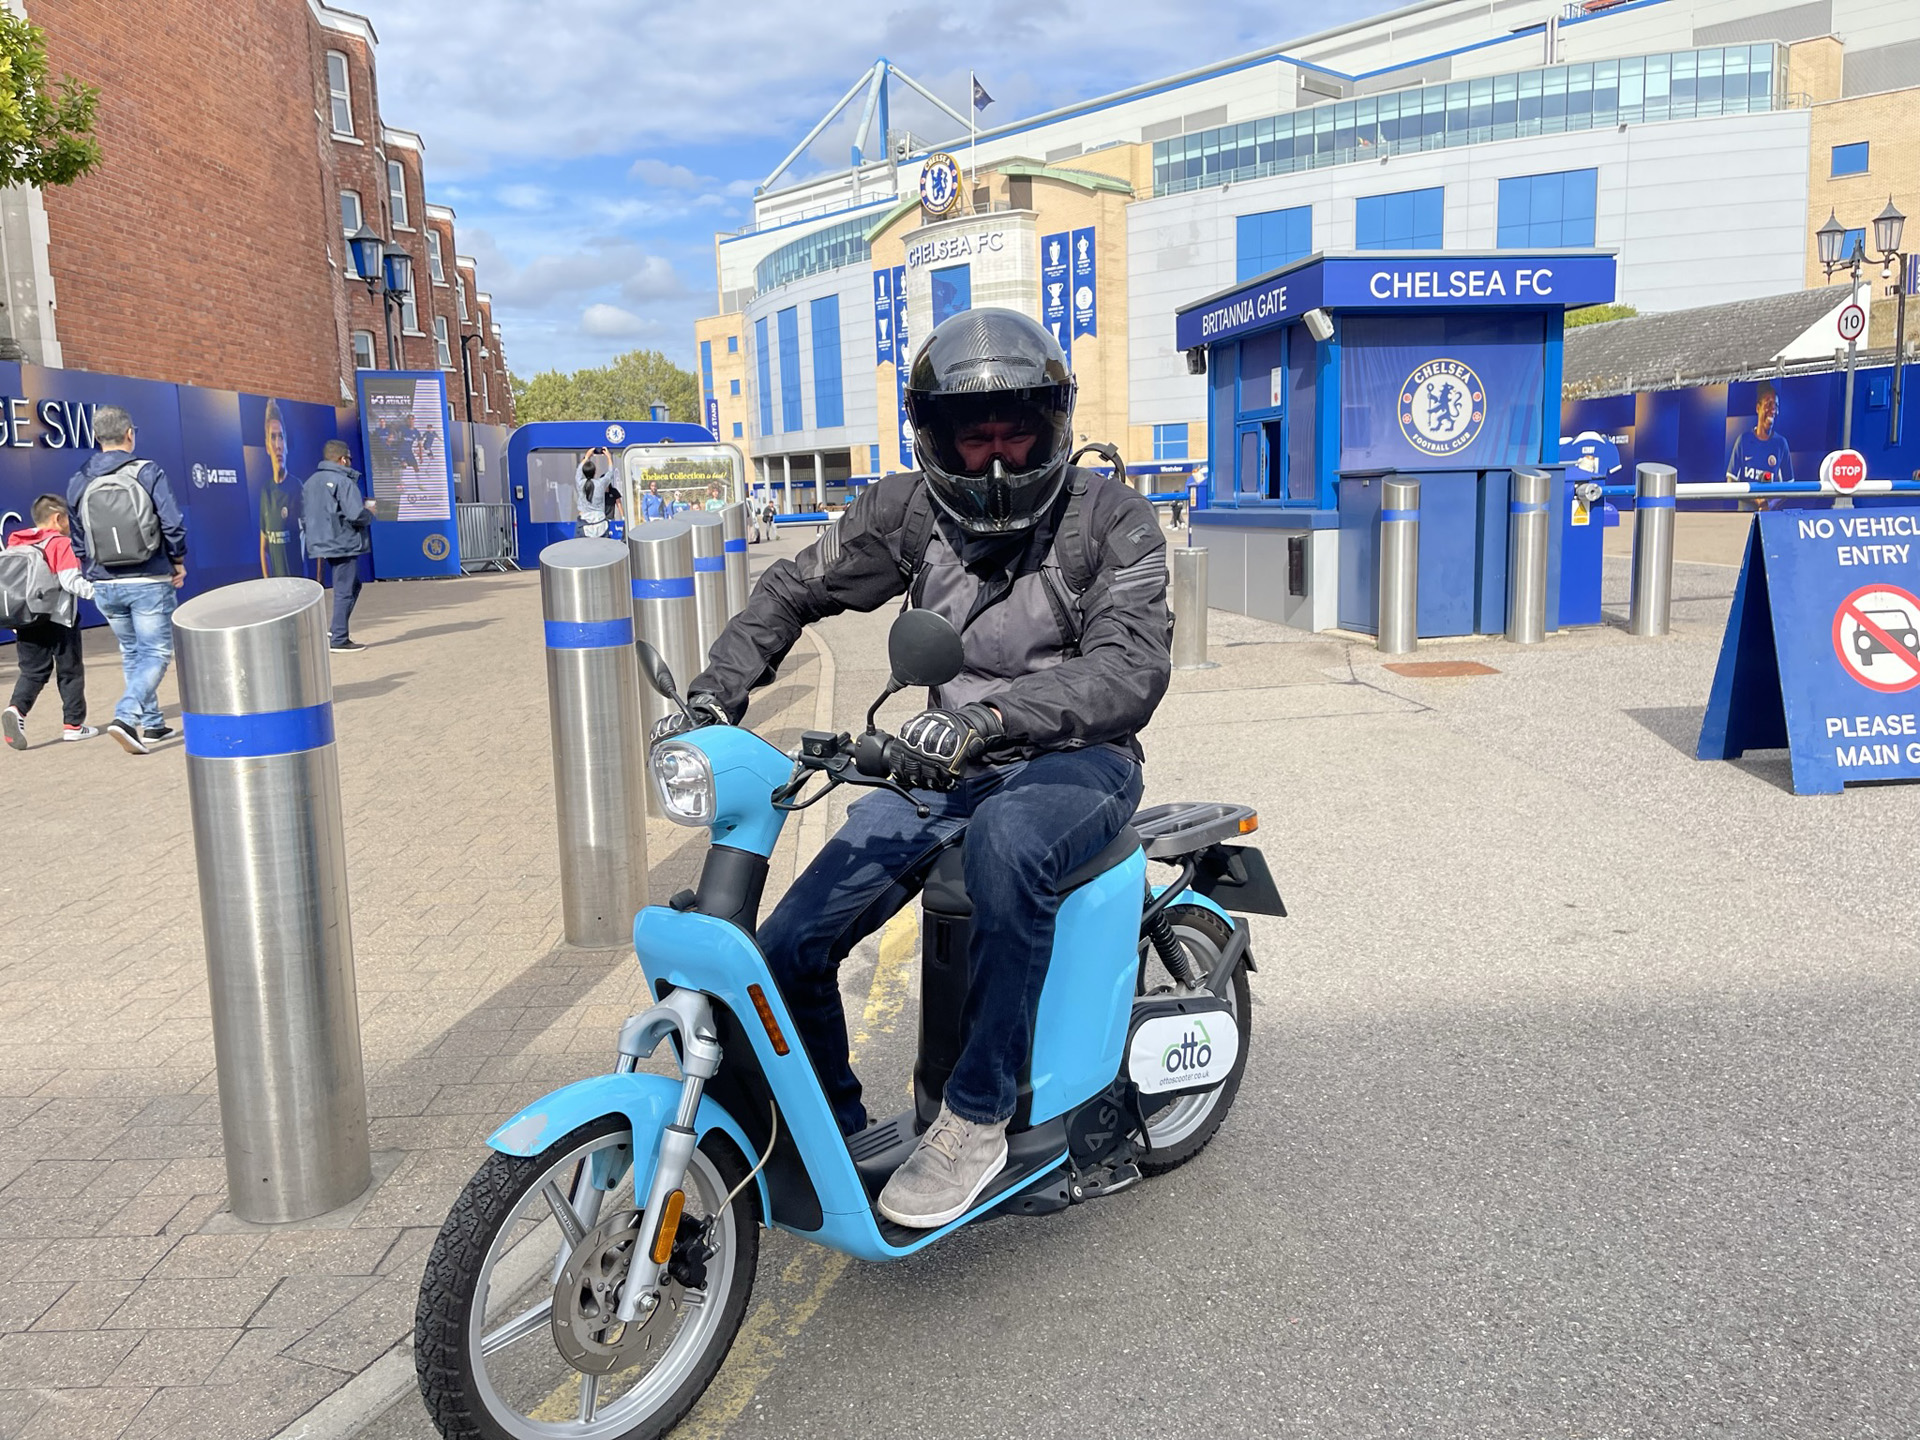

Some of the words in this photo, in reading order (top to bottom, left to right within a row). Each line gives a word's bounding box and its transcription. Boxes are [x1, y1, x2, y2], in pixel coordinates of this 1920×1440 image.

[924, 154, 951, 171] CHELSEA
[908, 235, 972, 269] CHELSEA
[977, 232, 1004, 254] FC
[1369, 269, 1507, 299] CHELSEA
[1514, 268, 1554, 296] FC
[1202, 298, 1255, 337] BRITANNIA
[1257, 286, 1287, 318] GATE
[1844, 314, 1860, 330] 10
[1414, 362, 1471, 384] CHELSEA
[1412, 433, 1450, 451] FOOTBALL
[1452, 431, 1471, 448] CLUB
[641, 472, 669, 481] Chelsea
[669, 471, 705, 480] Collection
[1834, 465, 1861, 476] STOP
[1798, 518, 1834, 540] NO
[1837, 544, 1910, 567] ENTRY
[1826, 714, 1917, 739] PLEASE
[1836, 745, 1900, 768] MAIN
[1166, 1031, 1212, 1073] otto
[1159, 1070, 1210, 1086] ottoscooter.co.uk
